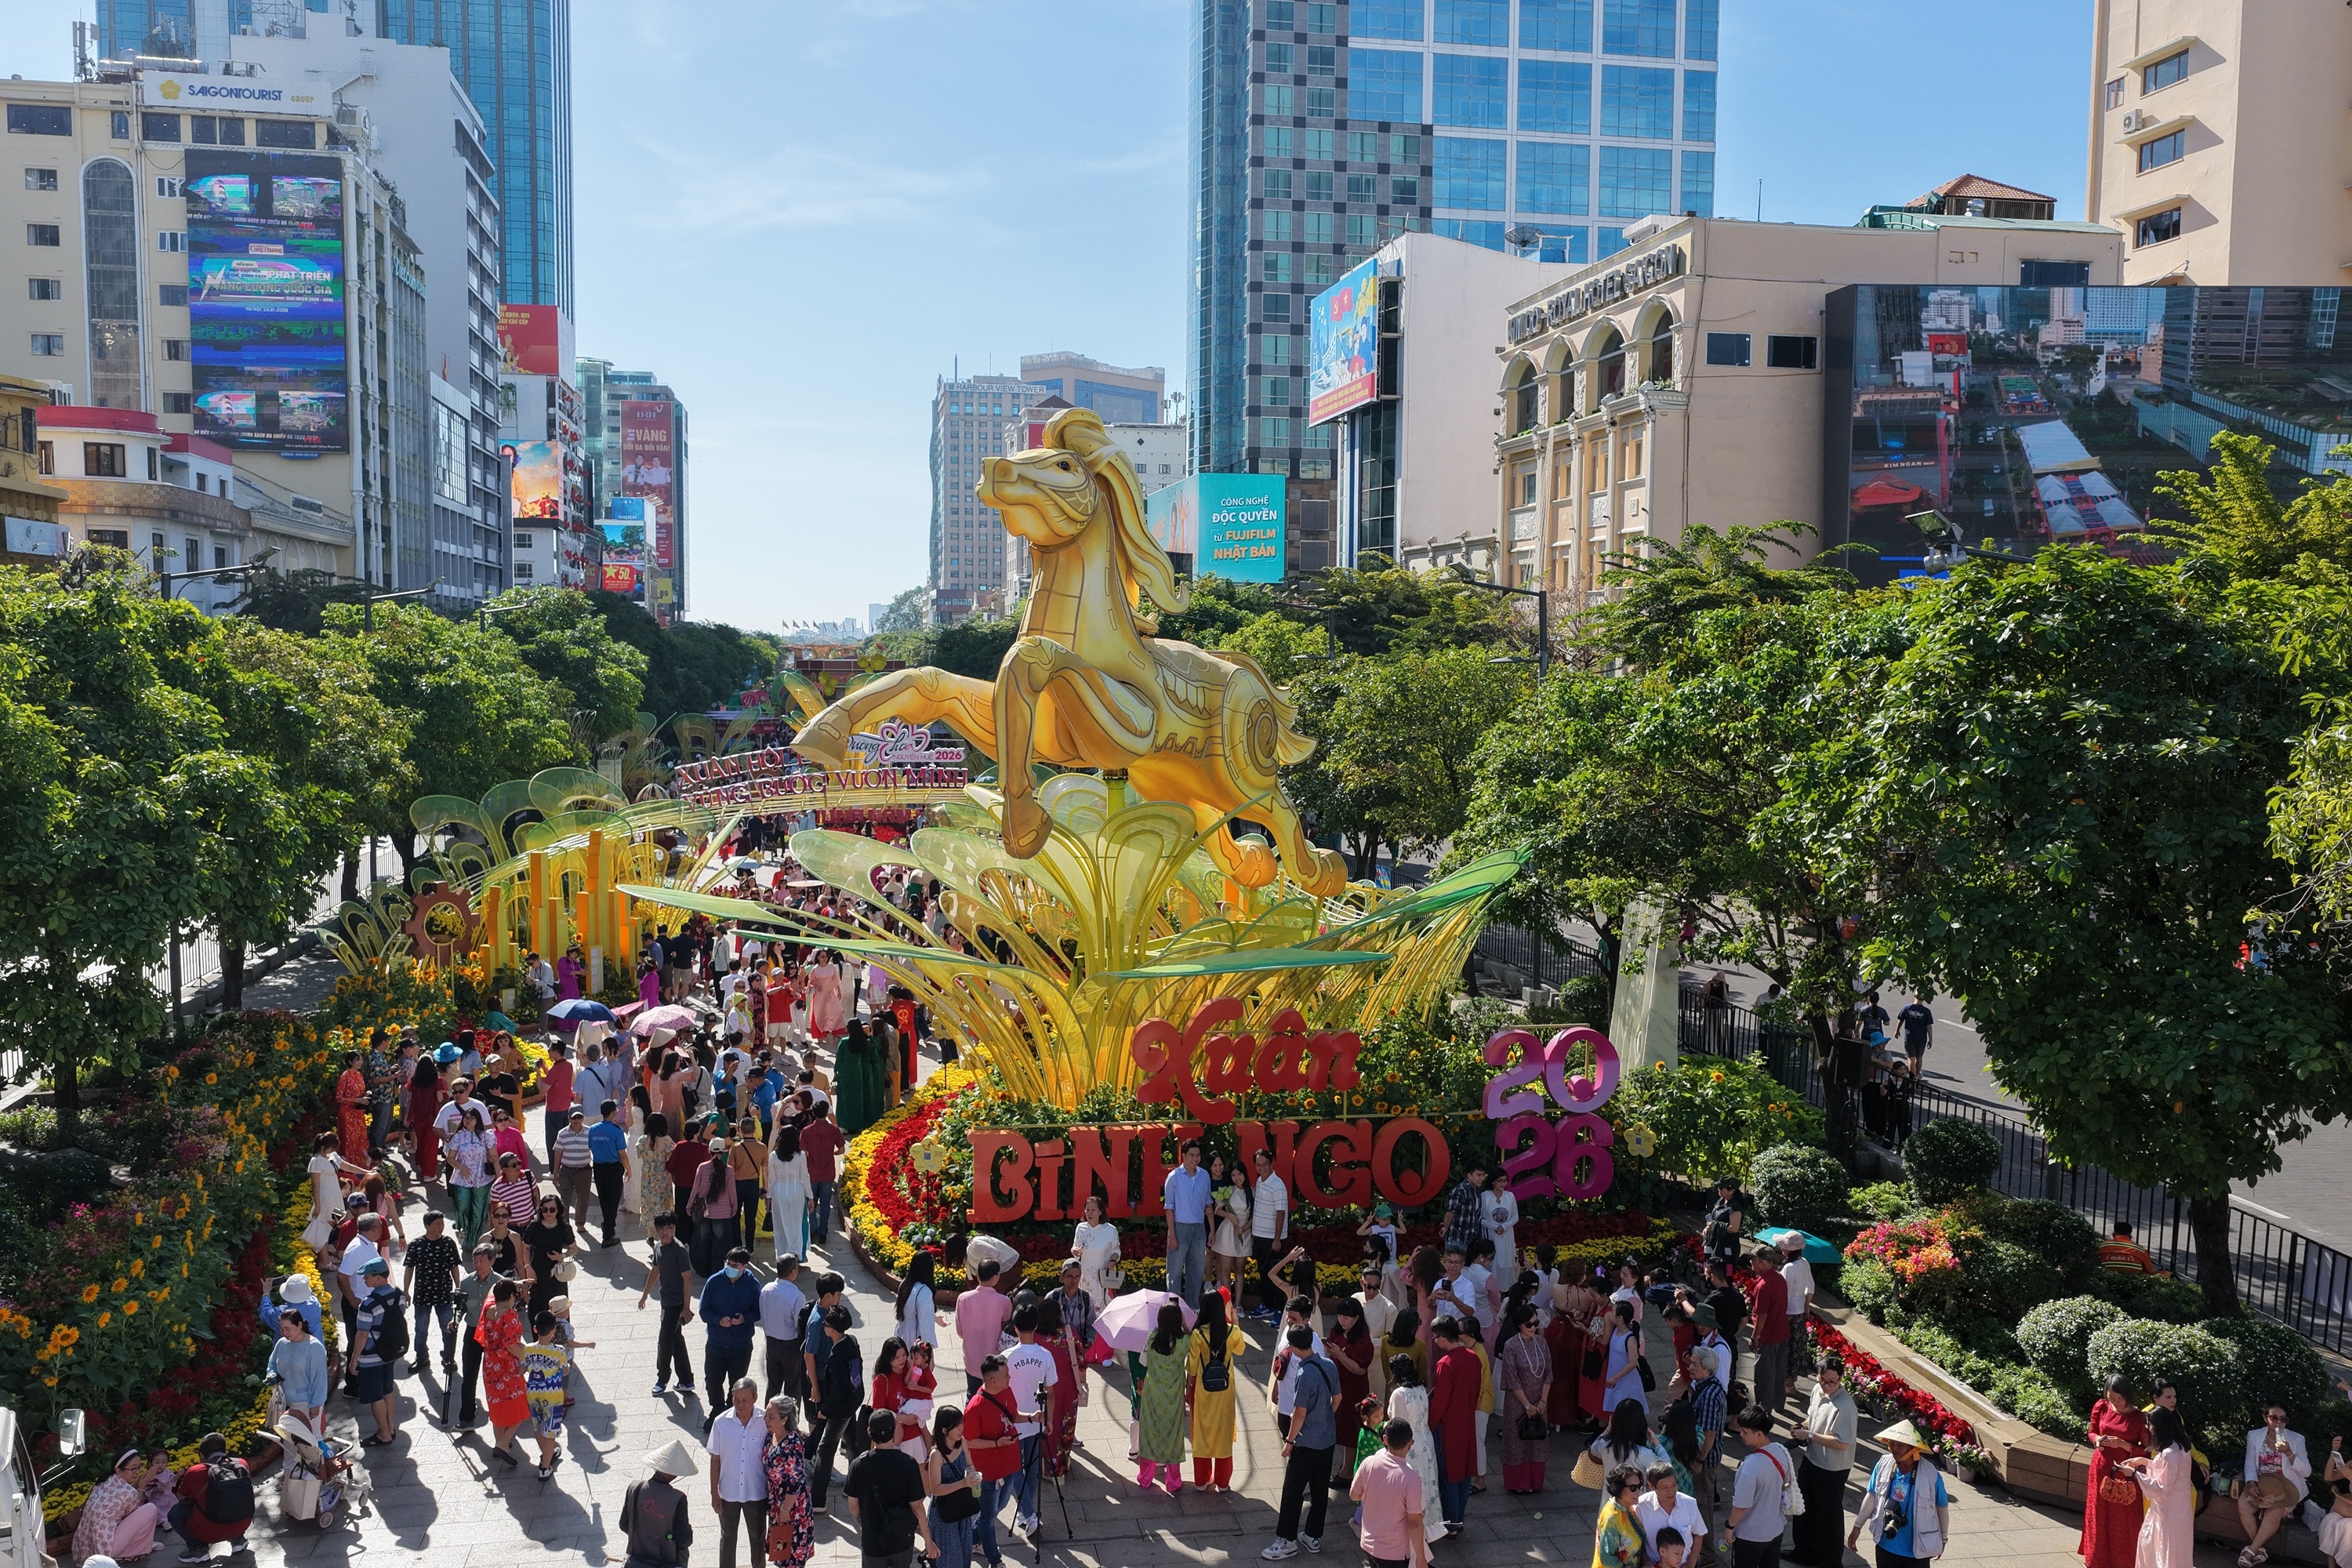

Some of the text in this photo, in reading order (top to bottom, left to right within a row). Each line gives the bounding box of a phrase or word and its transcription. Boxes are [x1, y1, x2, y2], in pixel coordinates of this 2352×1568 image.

[188, 85, 314, 103] SAIGONTOURIST GROUP
[299, 268, 330, 282] TRIỂN
[314, 286, 332, 295] GIA
[1547, 288, 1581, 328] ROYAL
[1583, 270, 1621, 311] HOTEL
[1624, 244, 1678, 294] SAIGON
[956, 383, 993, 392] HARBOUR
[636, 426, 666, 442] VÀNG
[1221, 495, 1269, 506] CÔNG NGHỆ
[1212, 507, 1277, 525] ĐỘC QUYỀN
[1214, 528, 1276, 542] từ FUJIFILM
[1214, 543, 1276, 561] NHẬT BẢN
[619, 567, 630, 579] 50
[920, 753, 934, 761] HUỆ
[935, 750, 962, 760] 2026
[674, 756, 742, 786] XUÂN
[746, 746, 784, 772] HỘI
[834, 768, 898, 790] VƯƠN
[904, 764, 968, 789] MÌNH
[1131, 996, 1362, 1125] Xuân
[1483, 1026, 1621, 1120] 20
[1494, 1112, 1615, 1202] 26
[525, 1354, 555, 1368] STEVE
[1014, 1357, 1043, 1370] MBAPPE
